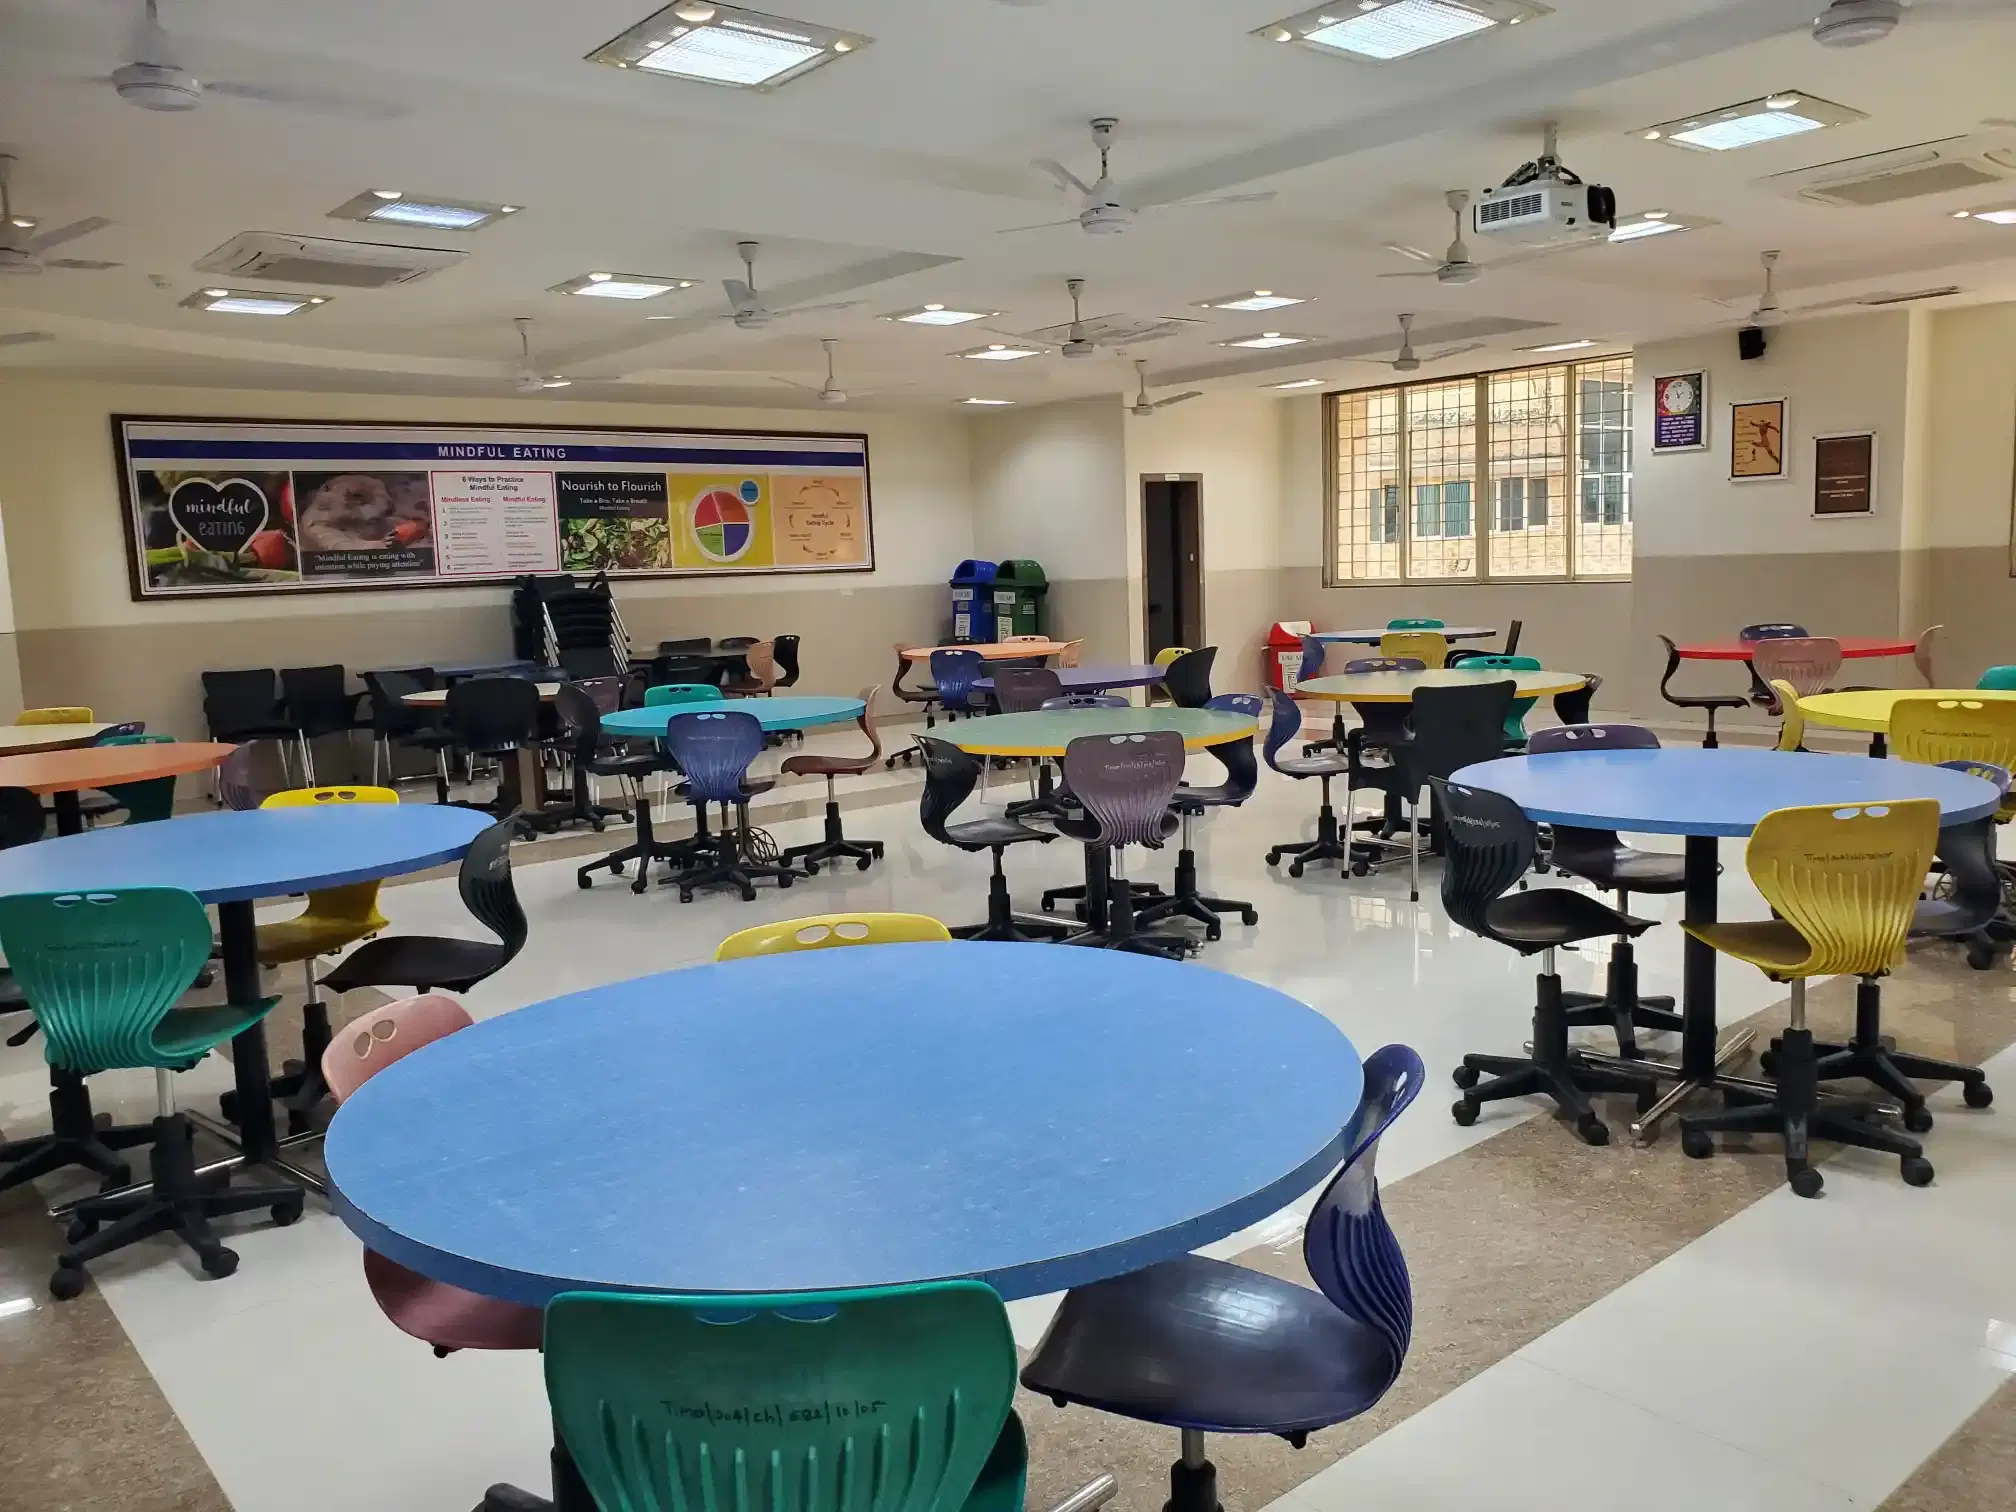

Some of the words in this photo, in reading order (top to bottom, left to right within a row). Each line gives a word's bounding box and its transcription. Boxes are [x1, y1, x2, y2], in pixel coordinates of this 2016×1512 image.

[438, 446, 506, 458] MINDFUL
[513, 447, 566, 459] EATING
[497, 484, 519, 492] Eating
[561, 480, 605, 491] Nourish
[607, 482, 618, 491] to
[621, 480, 661, 492] Flourish
[185, 498, 251, 515] mindful
[378, 552, 399, 561] eating
[401, 551, 416, 559] with
[367, 561, 390, 570] paying
